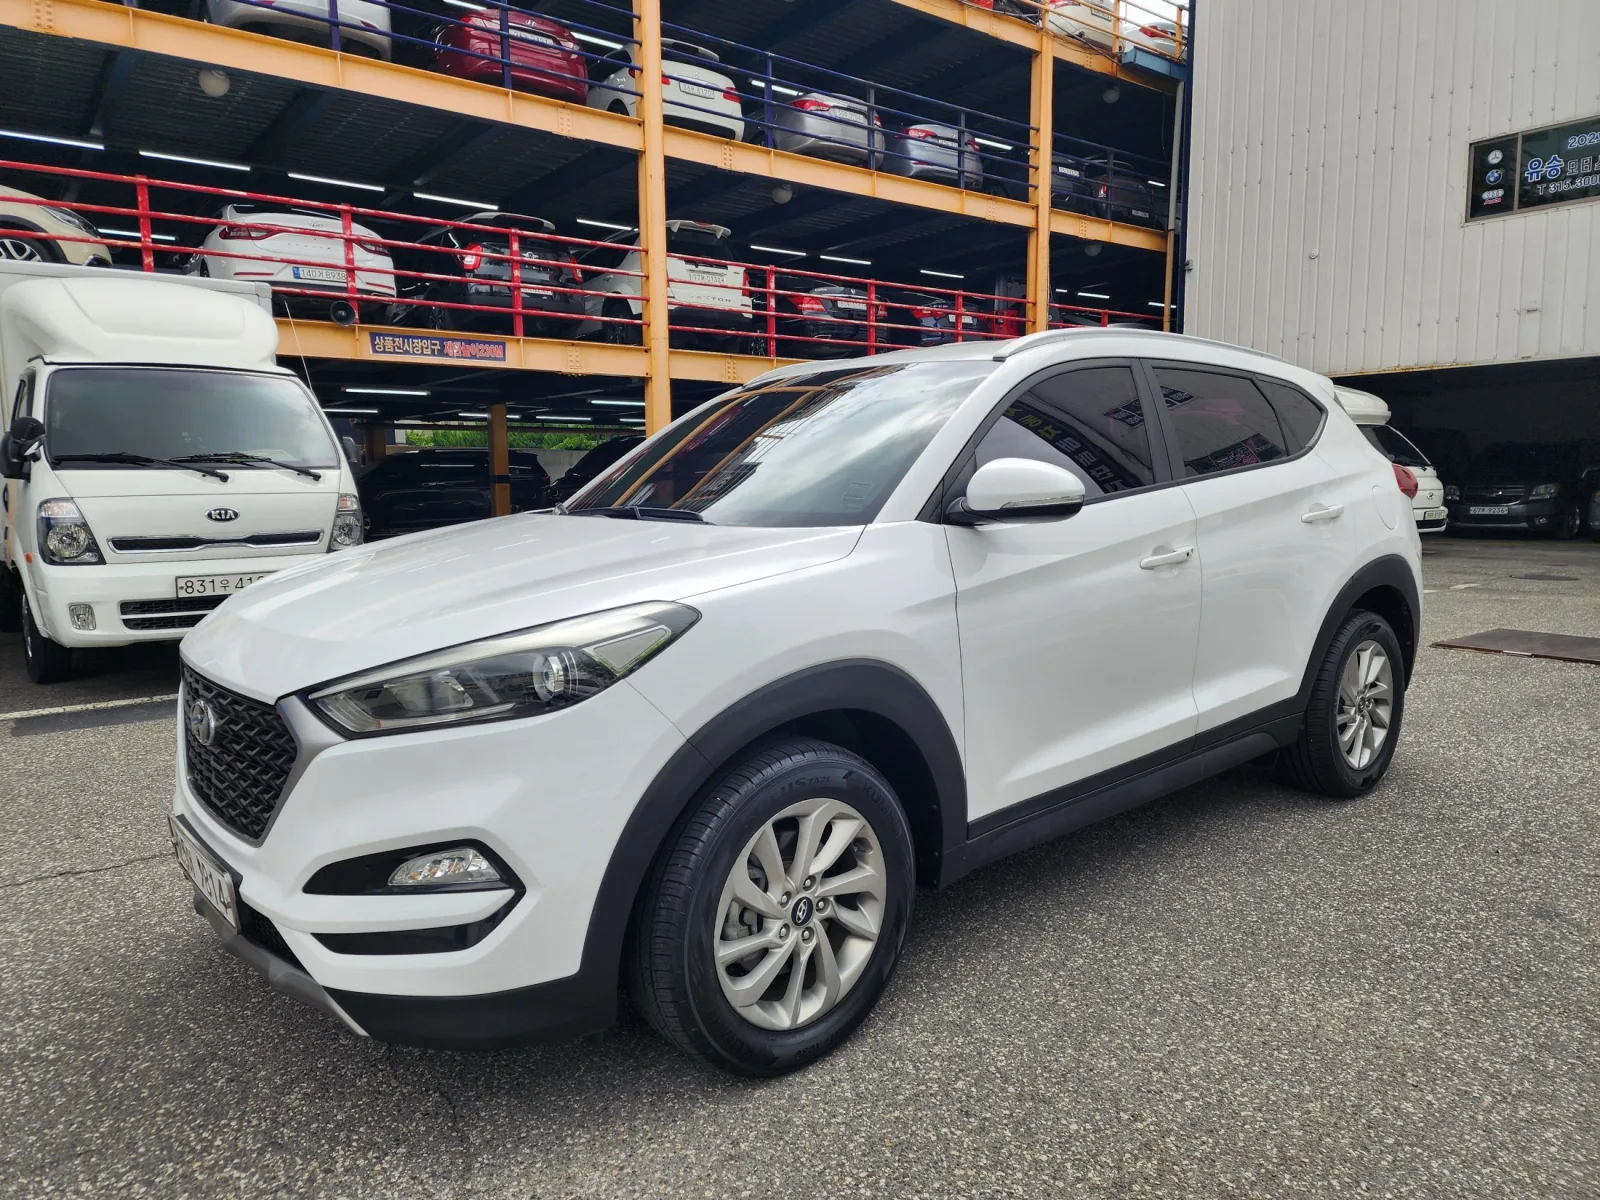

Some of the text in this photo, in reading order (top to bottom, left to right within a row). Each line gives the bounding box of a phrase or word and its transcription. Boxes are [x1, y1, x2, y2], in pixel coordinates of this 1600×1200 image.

[1525, 154, 1565, 183] 유승
[1536, 183, 1547, 195] T
[325, 270, 347, 281] 8938
[374, 335, 441, 356] 상품전시장입구
[209, 509, 237, 520] KIA
